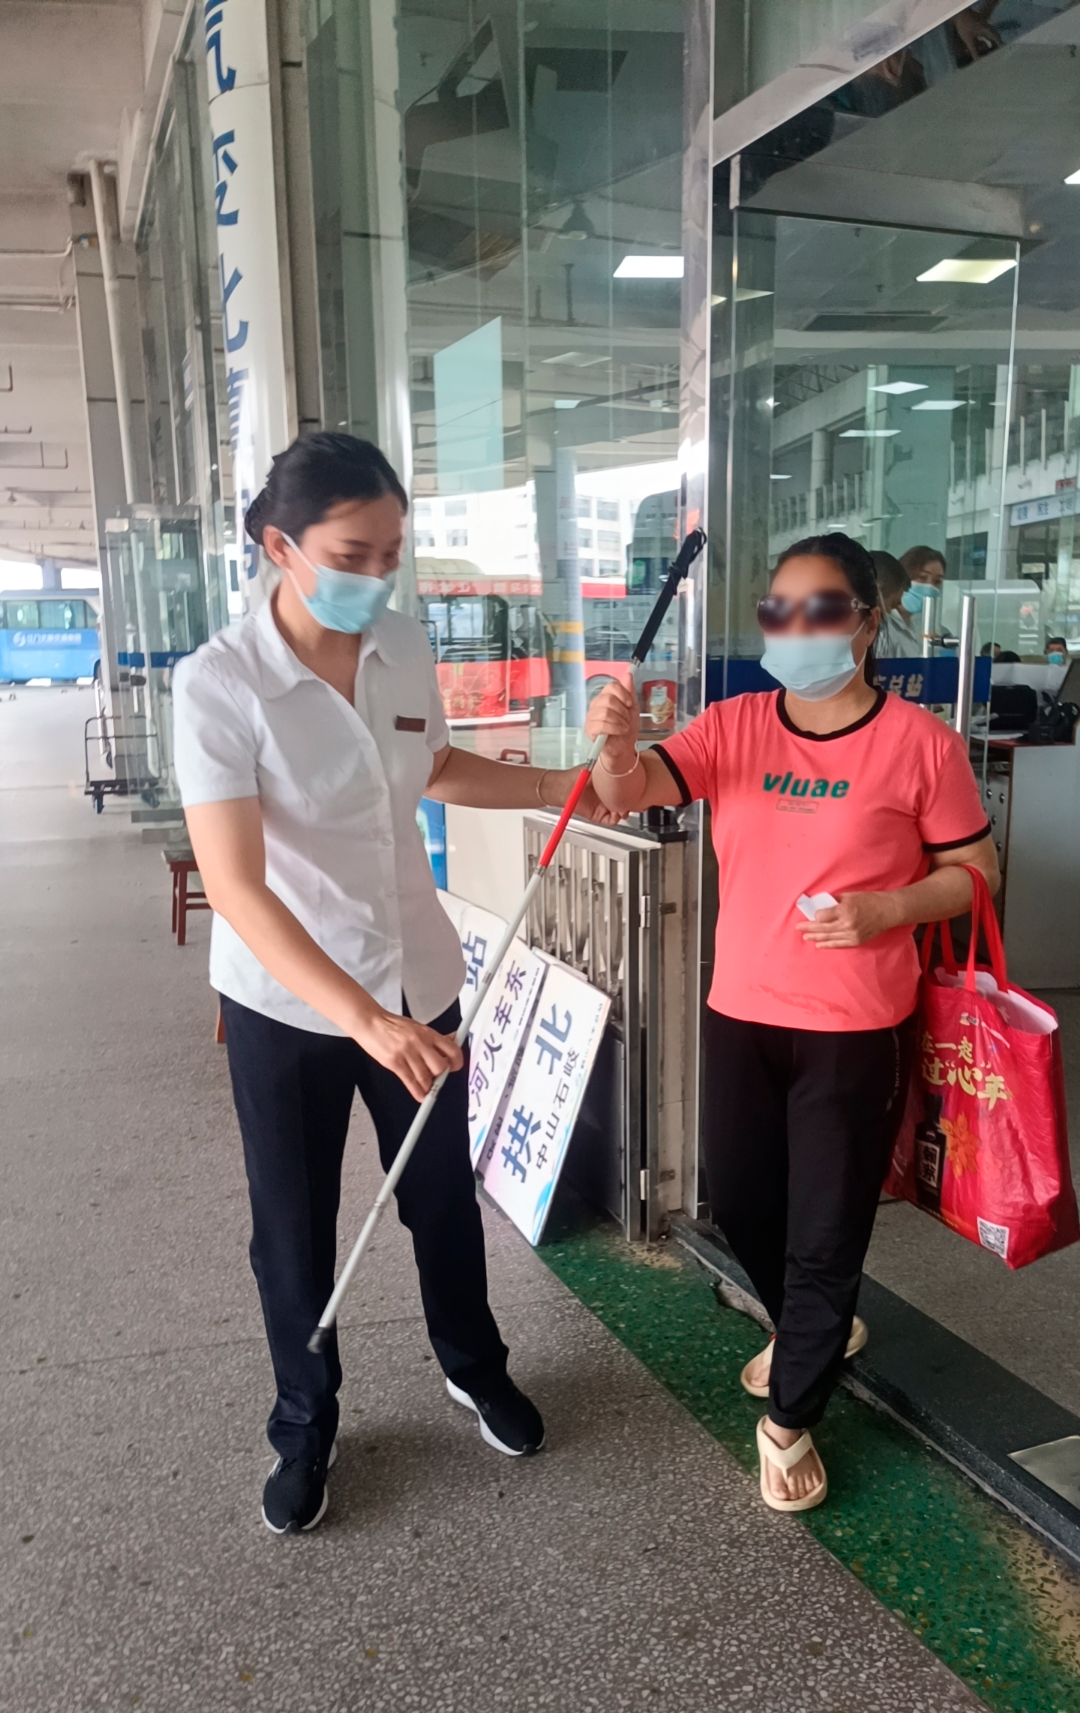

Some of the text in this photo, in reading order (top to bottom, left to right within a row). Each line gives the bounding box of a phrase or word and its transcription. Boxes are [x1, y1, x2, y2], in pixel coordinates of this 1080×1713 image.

[461, 931, 488, 992] 站
[468, 959, 527, 1122] 河火车东
[501, 1003, 573, 1183] 拱北
[535, 1047, 581, 1170] 中山石岐
